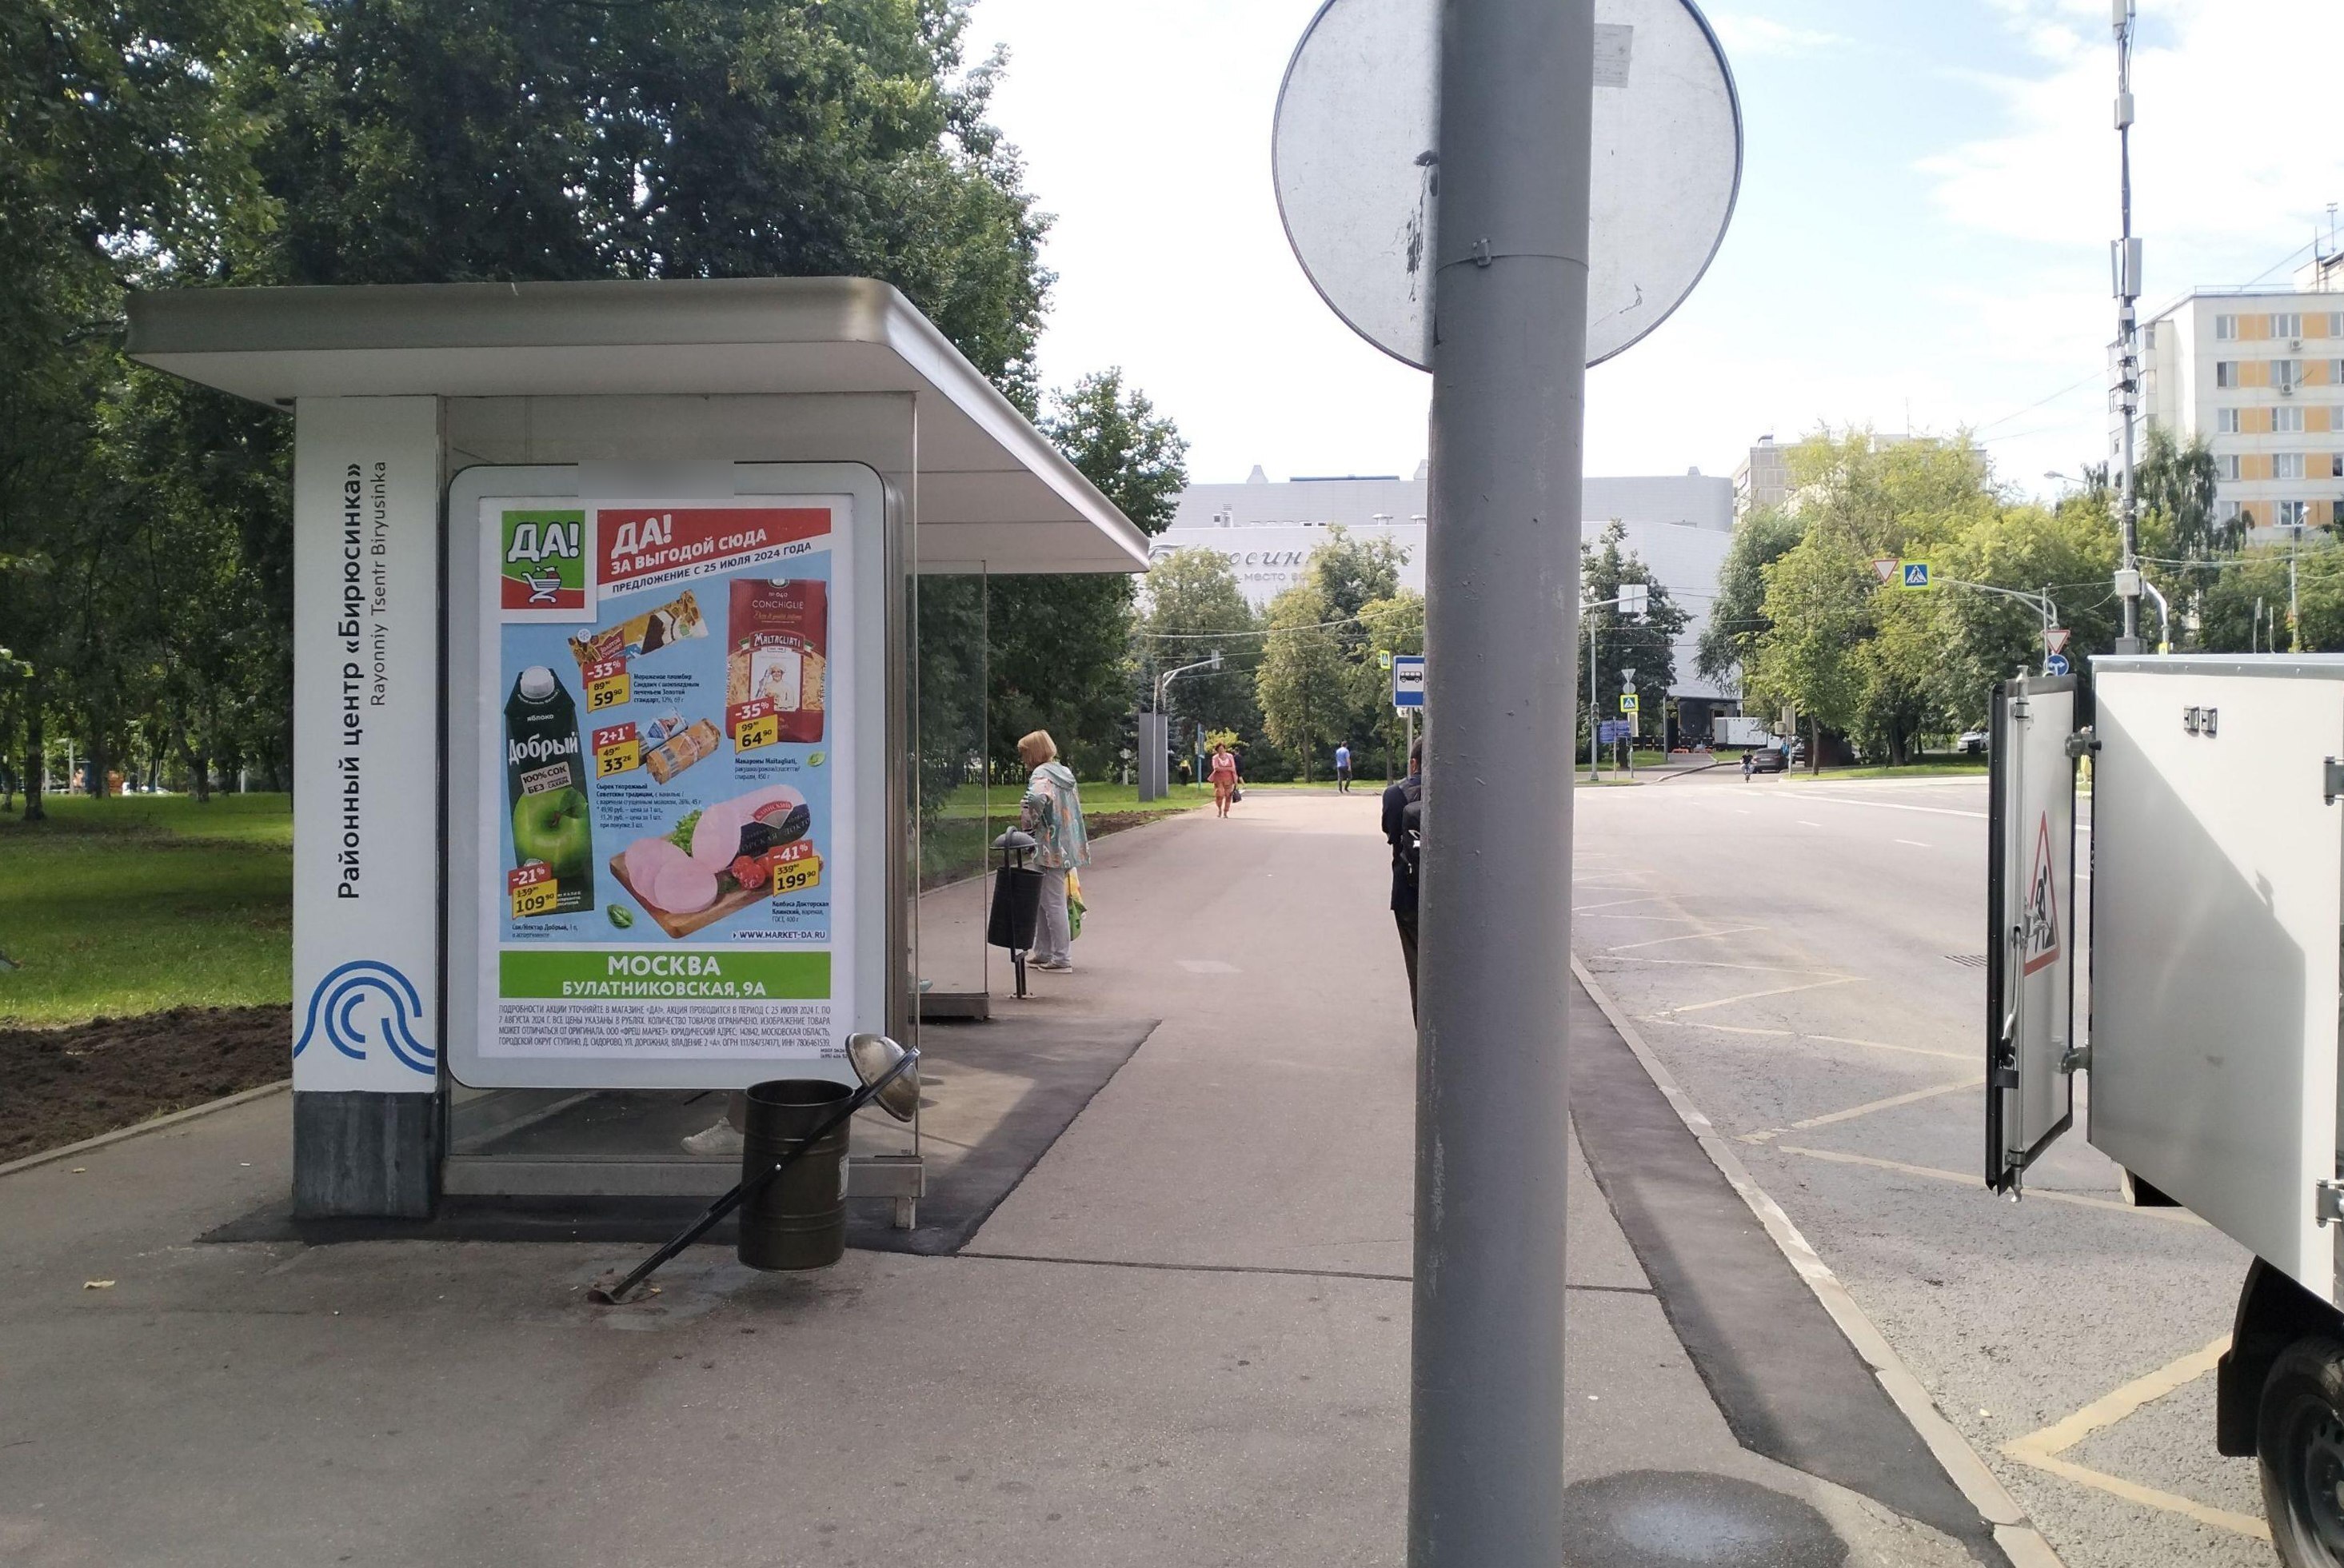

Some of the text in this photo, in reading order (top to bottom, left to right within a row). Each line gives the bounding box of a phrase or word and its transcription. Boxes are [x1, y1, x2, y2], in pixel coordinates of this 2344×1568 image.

[507, 521, 580, 564] ДА!
[611, 514, 672, 559] ДА!
[611, 529, 767, 576] ЗА ВЫГОДОЙ СЮДА
[370, 461, 389, 705] Rayonniy Tsentr Biryusinka
[613, 541, 812, 594] ПРЕДЛОЖЕНИЕ С 25 ИЮЛЯ 2024 ГОДА
[752, 600, 804, 609] CONCHIGLIE
[343, 663, 365, 745] центр
[509, 732, 578, 766] Добрый
[528, 784, 544, 793] БЕЗ
[548, 765, 567, 776] СОК
[337, 757, 360, 898] Районный
[608, 956, 721, 976] МОСКВА
[563, 981, 766, 998] БУЛАТНИКОВСКАЯ, 9А
[498, 1004, 544, 1014] ПОДРОБНОСТИ
[545, 1005, 567, 1014] АКЦИИ
[568, 1005, 603, 1014] УТОЧНЯЙТЕ
[611, 1005, 645, 1014] МАГАЗИНЕ
[666, 1005, 688, 1014] АКЦИЯ
